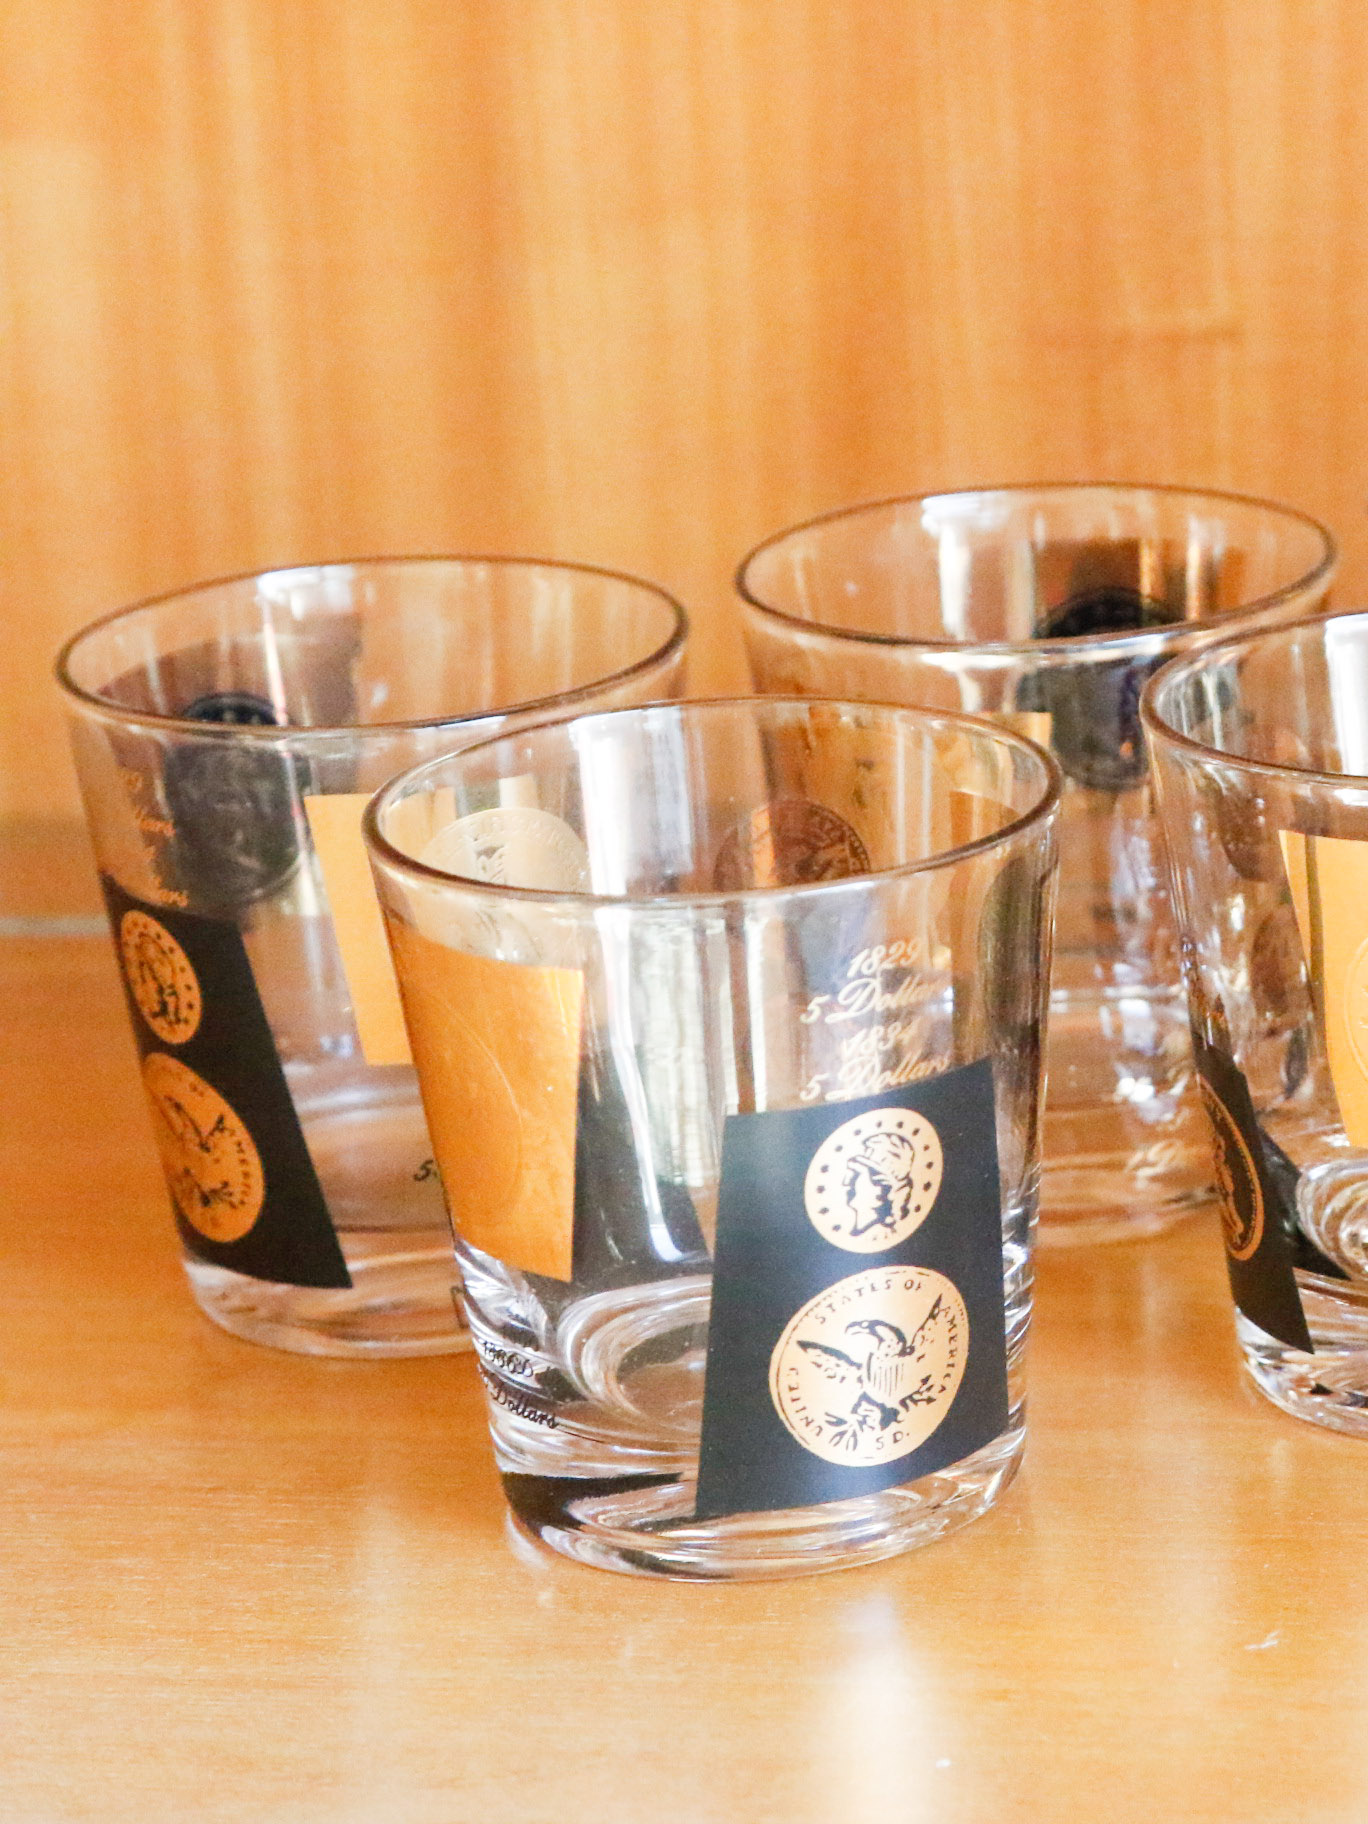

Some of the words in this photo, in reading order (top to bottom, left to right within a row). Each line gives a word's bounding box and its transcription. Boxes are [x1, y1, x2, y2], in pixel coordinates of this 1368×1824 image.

[846, 939, 919, 979] 1829
[799, 993, 832, 1025] 5
[799, 1072, 832, 1101] 5
